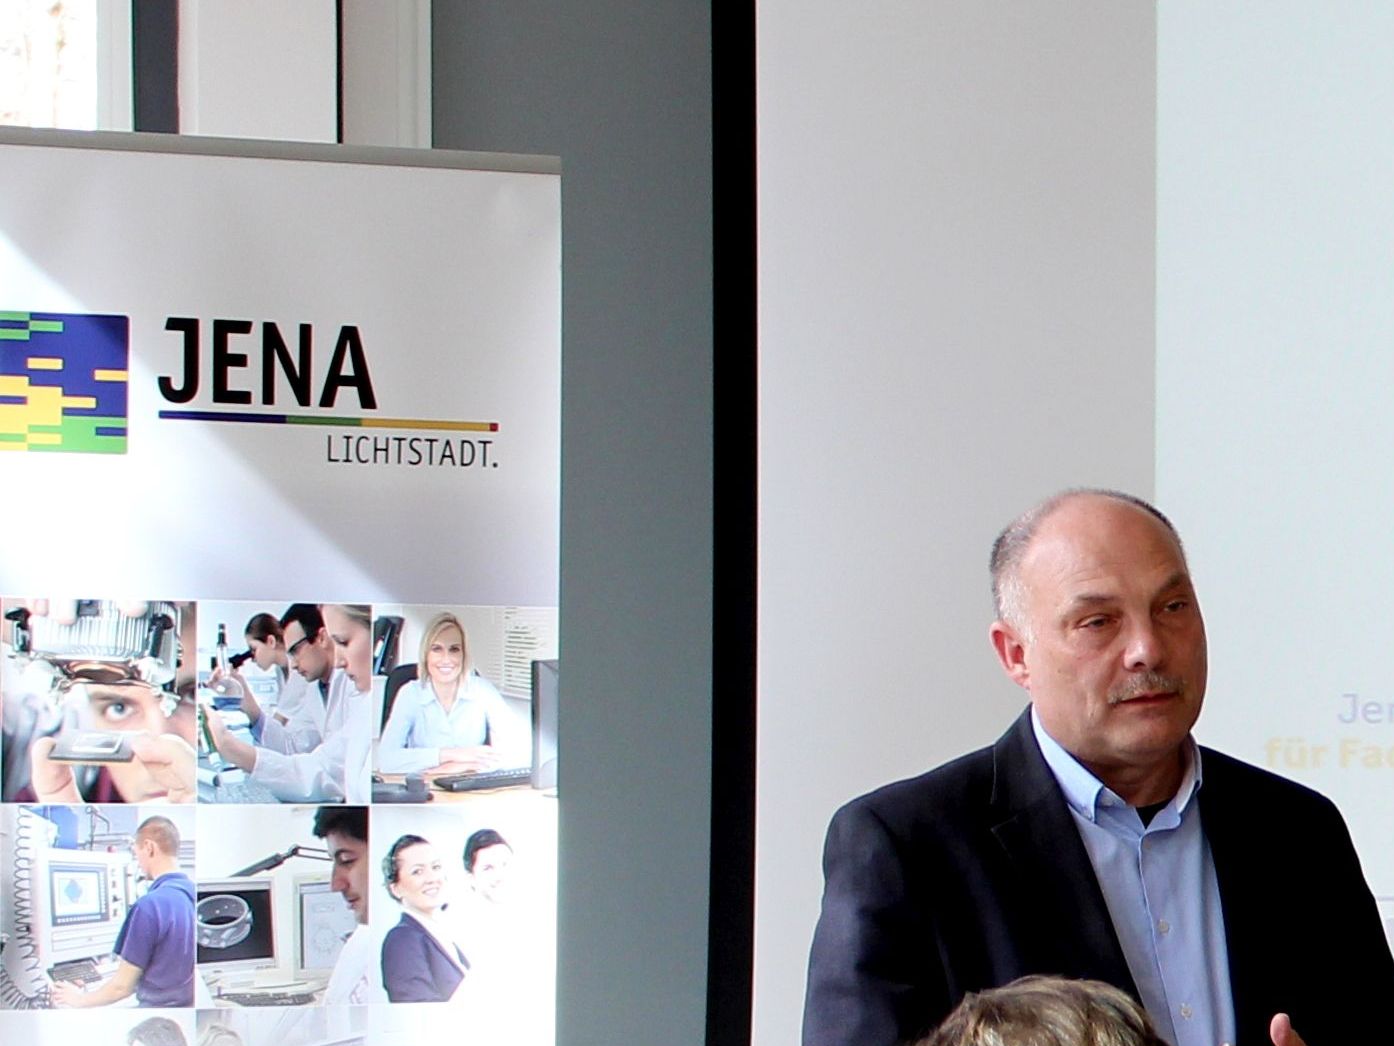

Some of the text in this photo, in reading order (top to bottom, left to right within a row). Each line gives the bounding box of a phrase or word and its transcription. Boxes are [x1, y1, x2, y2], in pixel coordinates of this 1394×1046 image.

[158, 316, 377, 410] JENA
[326, 435, 499, 468] LICHTSTADT.
[1264, 737, 1330, 769] für
